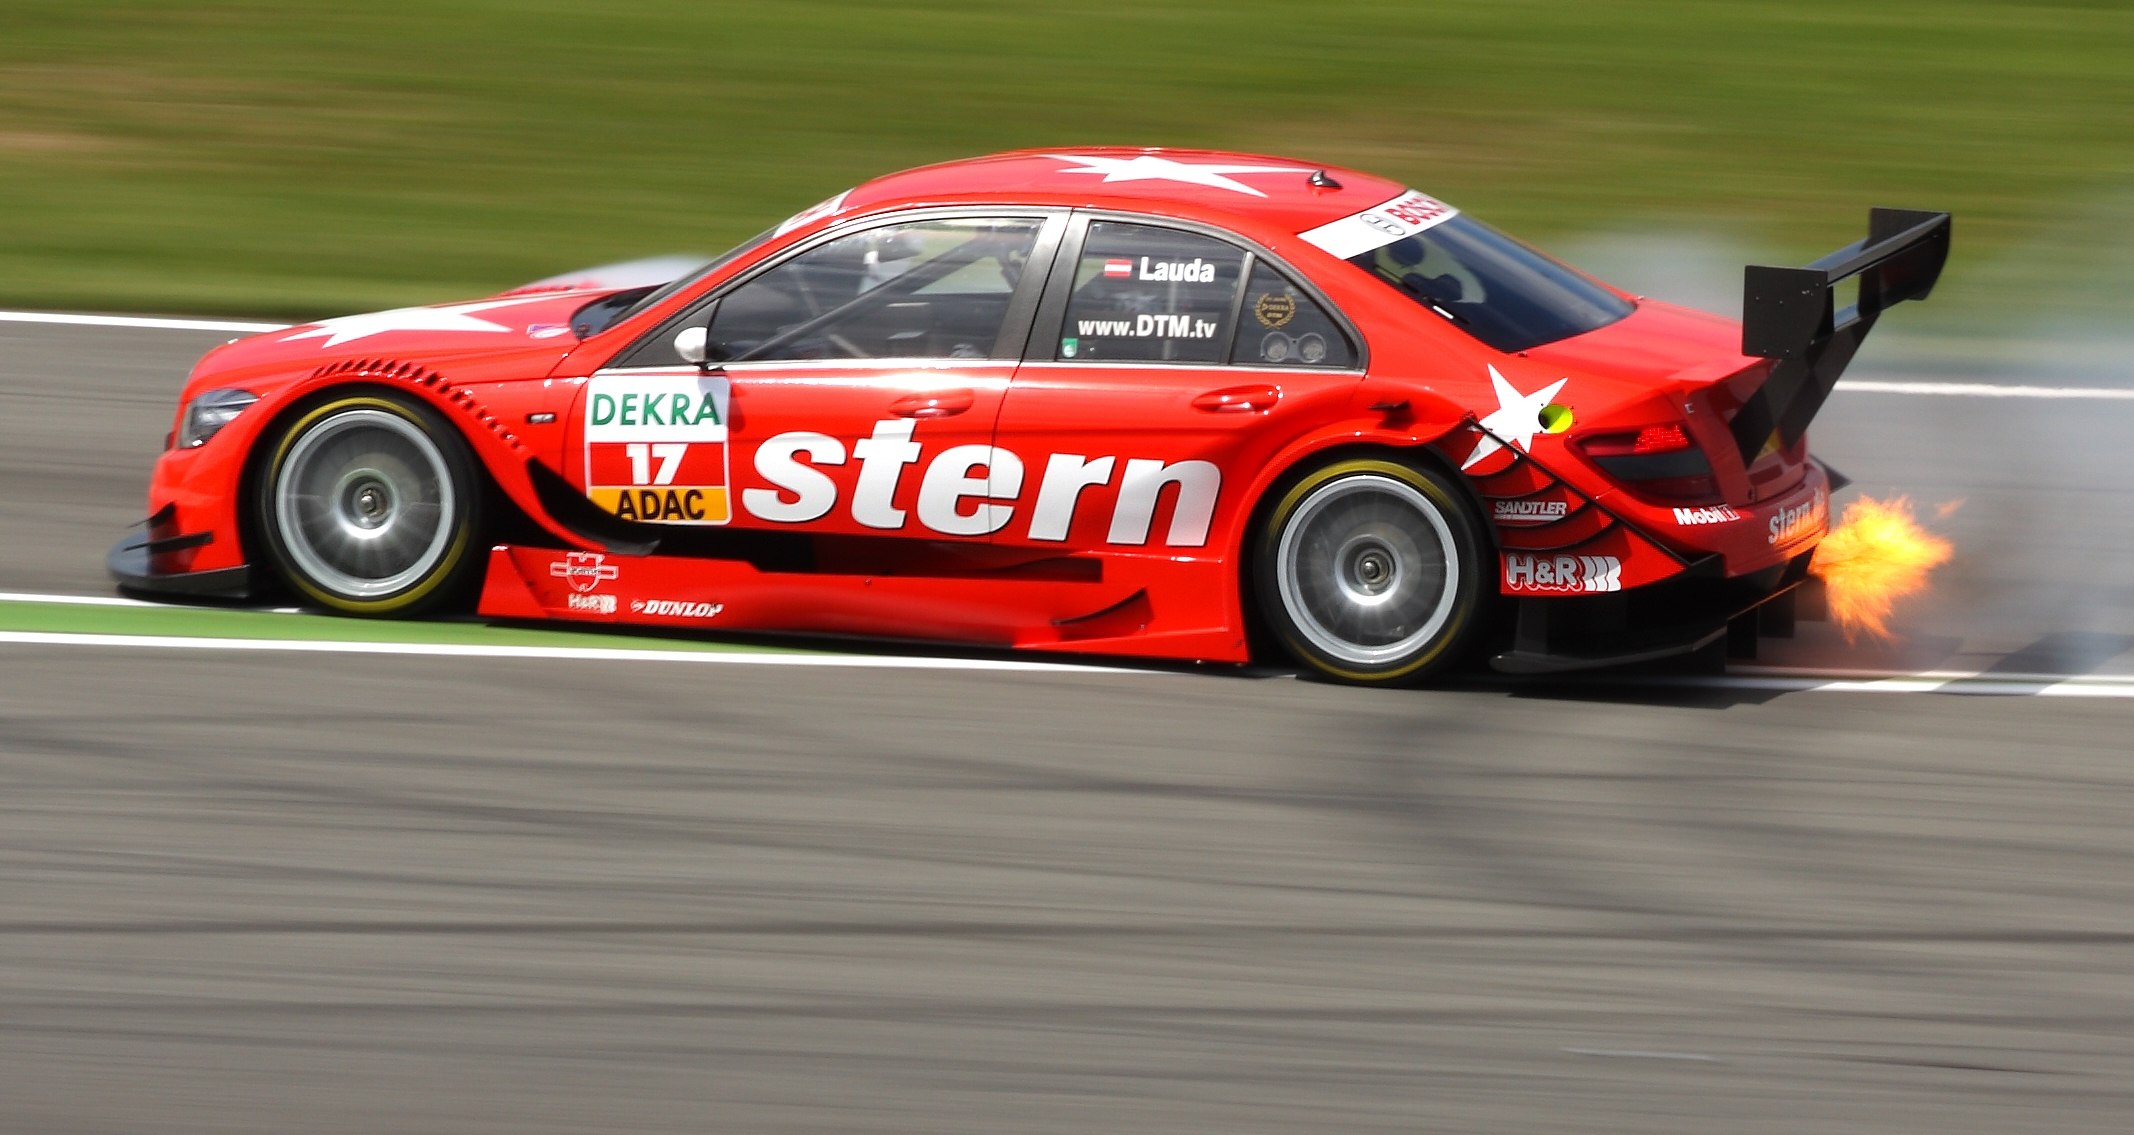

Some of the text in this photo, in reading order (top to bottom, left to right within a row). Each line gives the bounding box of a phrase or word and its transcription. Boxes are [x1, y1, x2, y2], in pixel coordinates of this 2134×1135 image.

[1139, 256, 1215, 282] Lauda
[1078, 314, 1217, 338] www.DTM.tv
[591, 391, 722, 426] DEKRA
[626, 443, 689, 485] 17
[741, 418, 1222, 546] stern
[614, 489, 705, 520] ADAC
[1494, 501, 1568, 515] SANDTLER
[1507, 555, 1580, 589] H&R
[642, 600, 725, 618] DUNLOP
